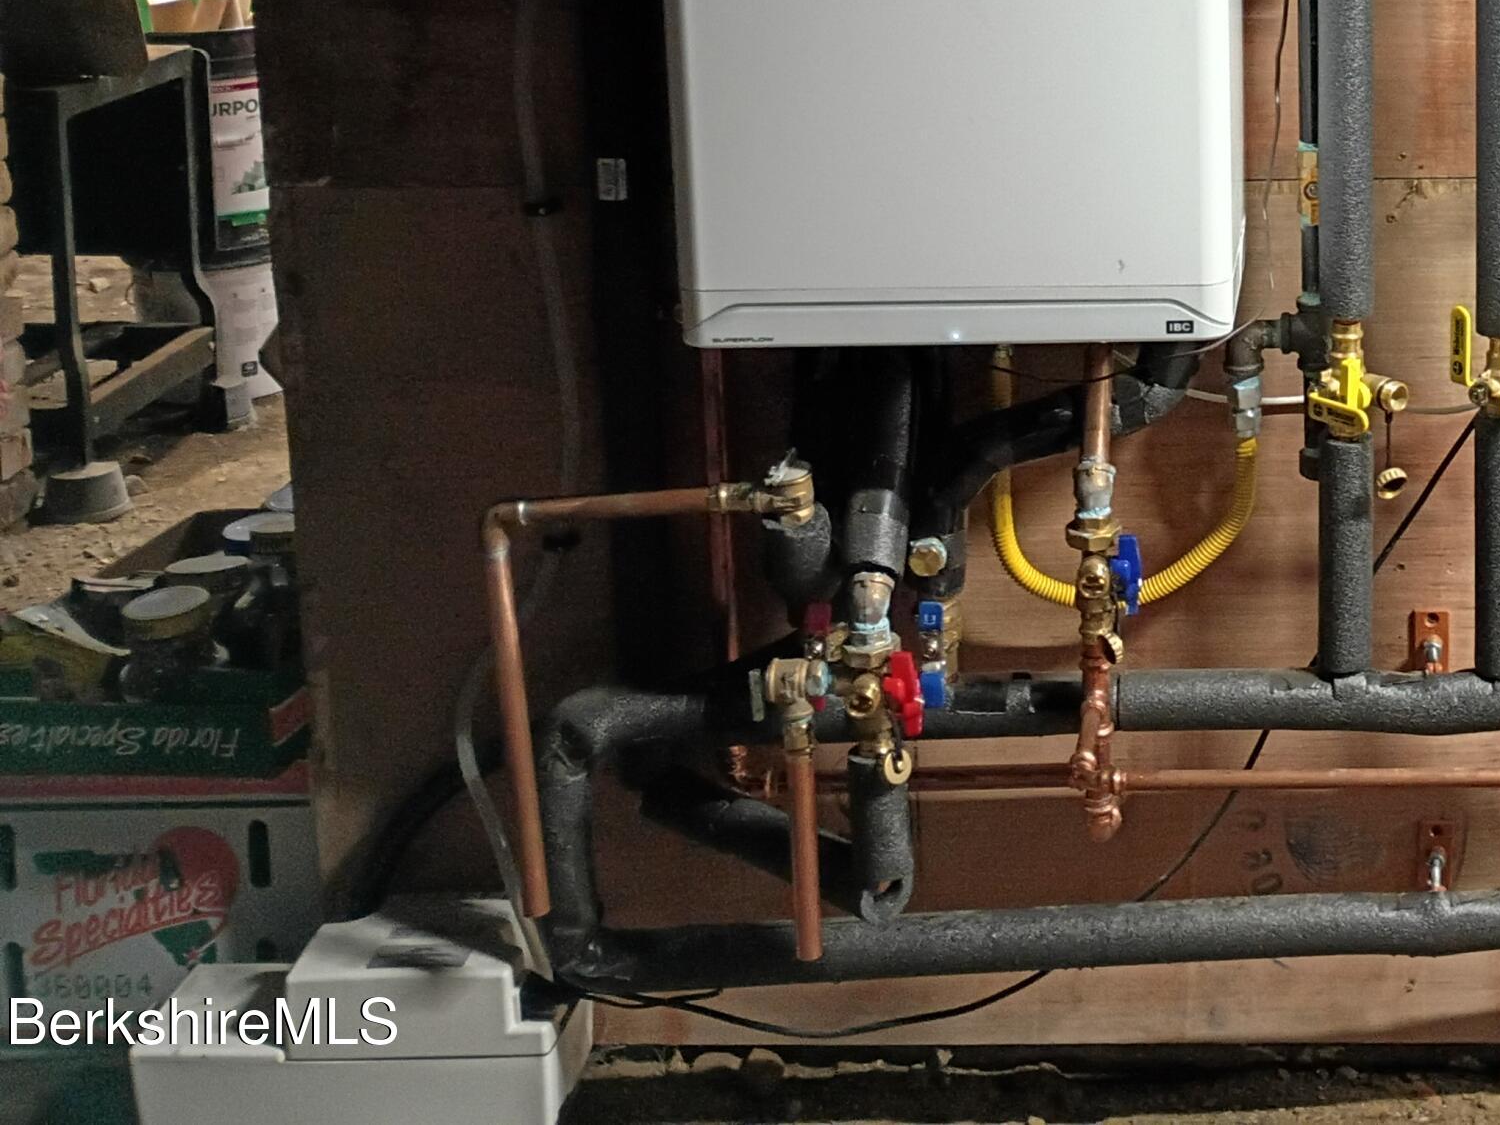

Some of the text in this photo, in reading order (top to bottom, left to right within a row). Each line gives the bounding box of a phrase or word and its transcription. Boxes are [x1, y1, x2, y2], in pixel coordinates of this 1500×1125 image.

[1169, 322, 1192, 332] IBC
[152, 725, 241, 758] Florida
[28, 871, 224, 969] Specialties
